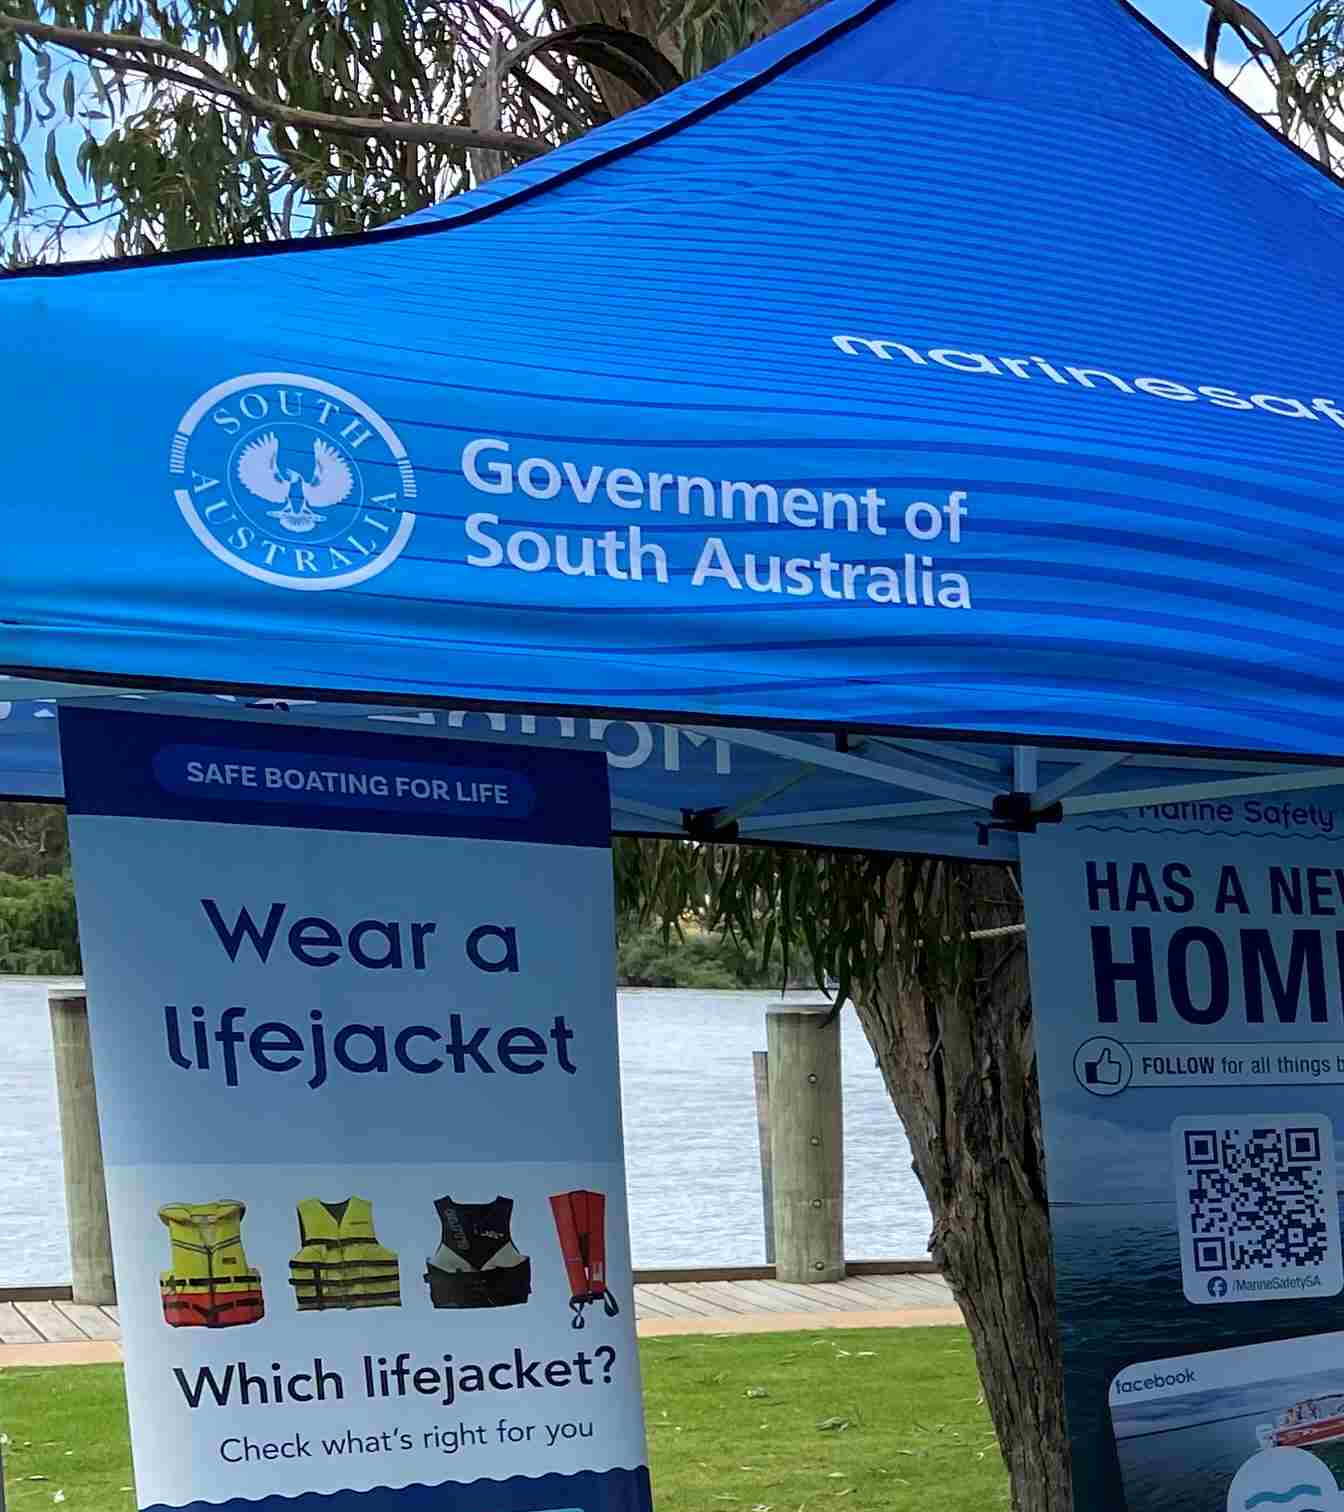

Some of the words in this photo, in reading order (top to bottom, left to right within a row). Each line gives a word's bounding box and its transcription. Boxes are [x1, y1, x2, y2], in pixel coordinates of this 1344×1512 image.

[212, 389, 369, 449] SOUTH
[462, 438, 890, 536] Government
[905, 491, 968, 544] of
[190, 470, 400, 577] AUSTRALIA
[464, 512, 669, 584] South
[691, 537, 973, 610] Australia
[186, 762, 258, 787] SAFE
[265, 767, 388, 796] BOATING
[395, 776, 450, 800] FOR
[457, 779, 509, 804] LIFE
[1246, 800, 1334, 832] Safety
[1085, 861, 1194, 913] HAS
[1215, 865, 1249, 914] A
[200, 898, 436, 970] Wear
[466, 923, 519, 973] a
[164, 1006, 577, 1089] lifejacket
[1142, 1056, 1215, 1075] FOLLOW
[1221, 1055, 1244, 1075] for
[1251, 1055, 1271, 1074] all
[1277, 1055, 1331, 1078] things
[175, 1357, 344, 1409] Which
[364, 1346, 617, 1406] lifejacket?
[1115, 1368, 1196, 1394] facebook
[220, 1432, 310, 1463] Check
[323, 1427, 412, 1457] what's
[424, 1423, 487, 1452] right
[496, 1418, 536, 1445] for
[545, 1421, 593, 1446] you
